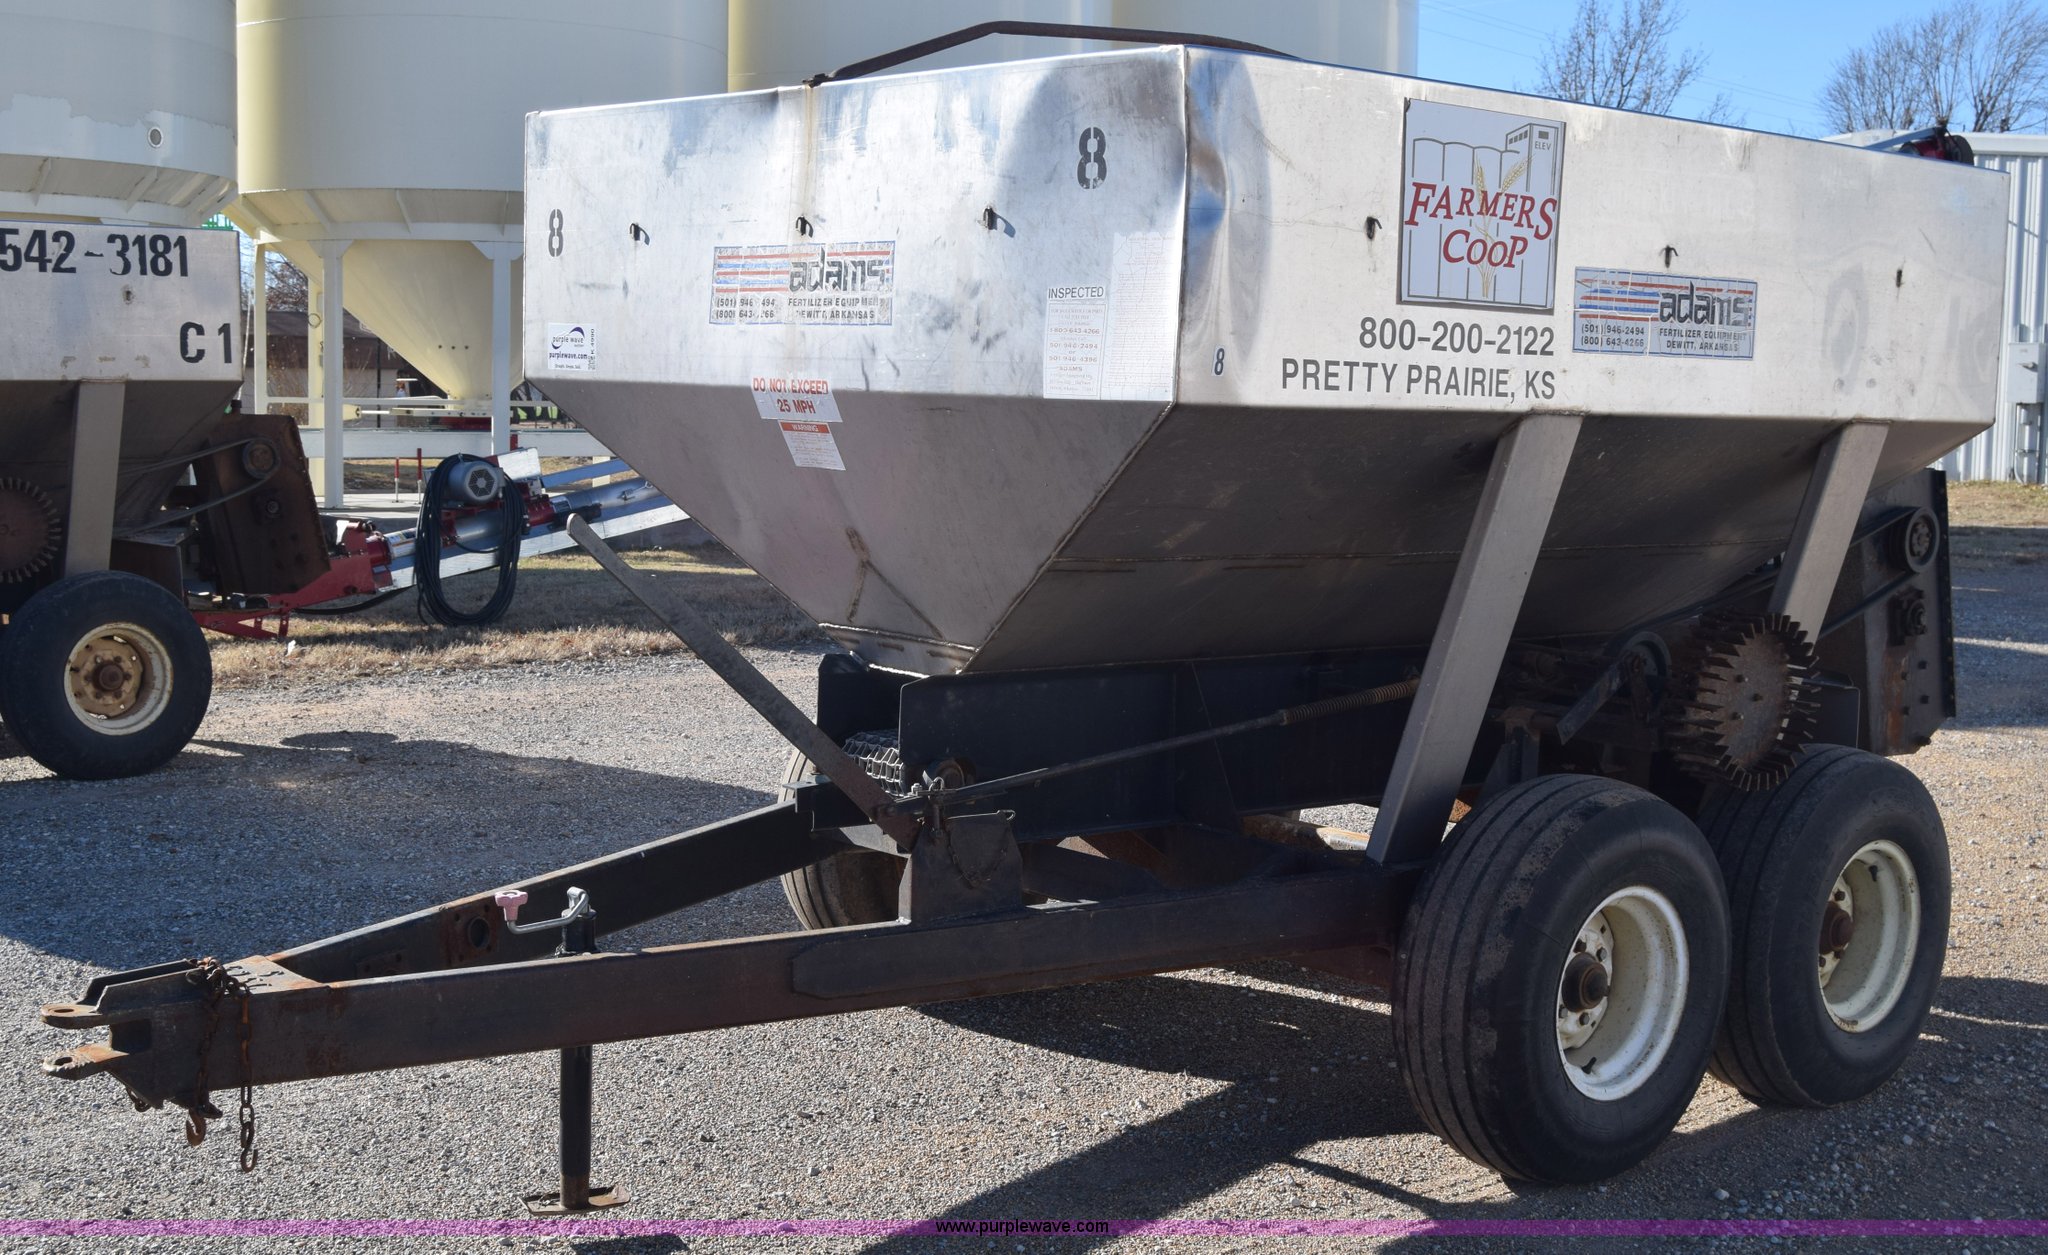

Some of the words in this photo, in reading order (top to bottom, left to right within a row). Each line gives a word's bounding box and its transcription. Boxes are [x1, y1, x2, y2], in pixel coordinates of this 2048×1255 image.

[1534, 140, 1552, 151] ELEV
[1077, 127, 1107, 190] 8
[1404, 182, 1558, 240] FARMERS
[547, 209, 565, 257] 8
[0, 228, 189, 277] 542-3181
[1048, 286, 1105, 299] INSPECTED
[787, 297, 833, 307] FERTILIZER
[1659, 280, 1749, 326] adams
[1359, 316, 1555, 357] 800-200-2122
[1581, 323, 1604, 334] (501)
[1606, 324, 1645, 336] 946-2494
[1659, 328, 1702, 339] FERTILIZER
[1581, 335, 1603, 347] (800)
[1606, 336, 1645, 347] 643-4266
[549, 351, 588, 360] purplewave.com
[1213, 348, 1225, 376] 8
[752, 377, 766, 392] DO
[769, 378, 787, 393] NOT
[791, 379, 829, 395] EXCEED
[1282, 358, 1398, 393] PRETTY
[1405, 364, 1516, 404] PRAIRIE,
[1524, 370, 1555, 400] KS
[777, 398, 791, 413] 25
[793, 399, 816, 414] MPH
